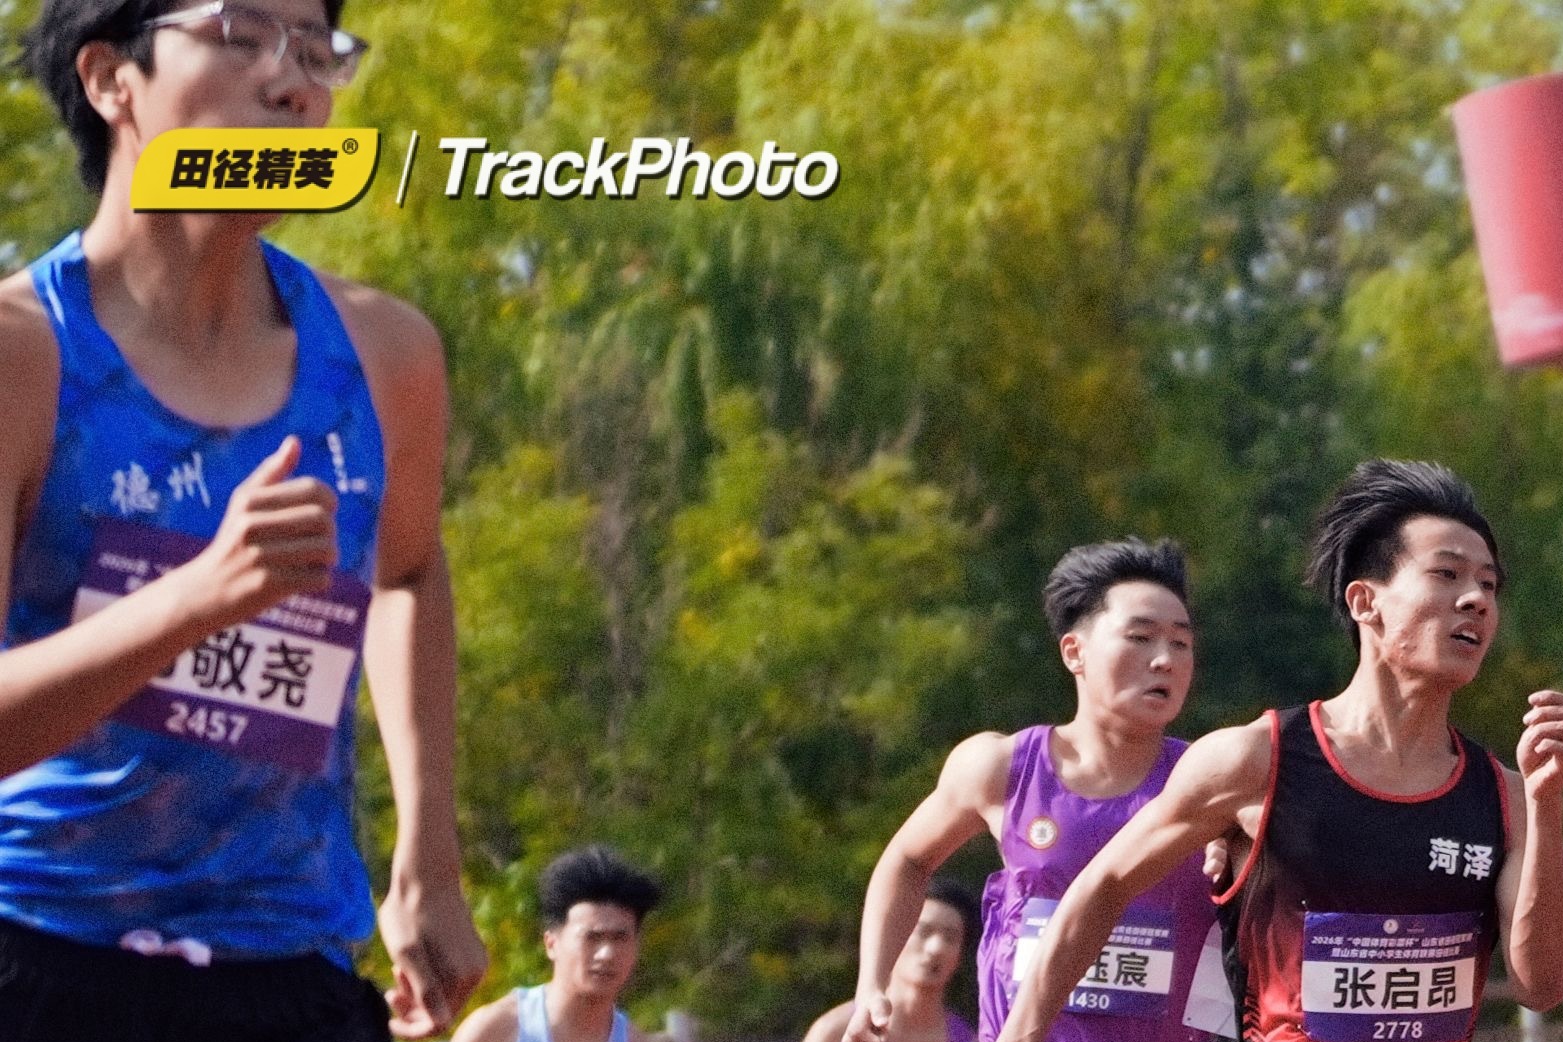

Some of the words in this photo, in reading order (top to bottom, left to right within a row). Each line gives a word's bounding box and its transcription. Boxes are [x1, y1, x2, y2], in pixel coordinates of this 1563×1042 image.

[158, 628, 314, 708] 敬尧
[164, 702, 249, 744] 2457
[1428, 837, 1493, 881] 菏泽
[1333, 966, 1457, 1010] 张启昂
[1372, 1020, 1423, 1040] 2778
